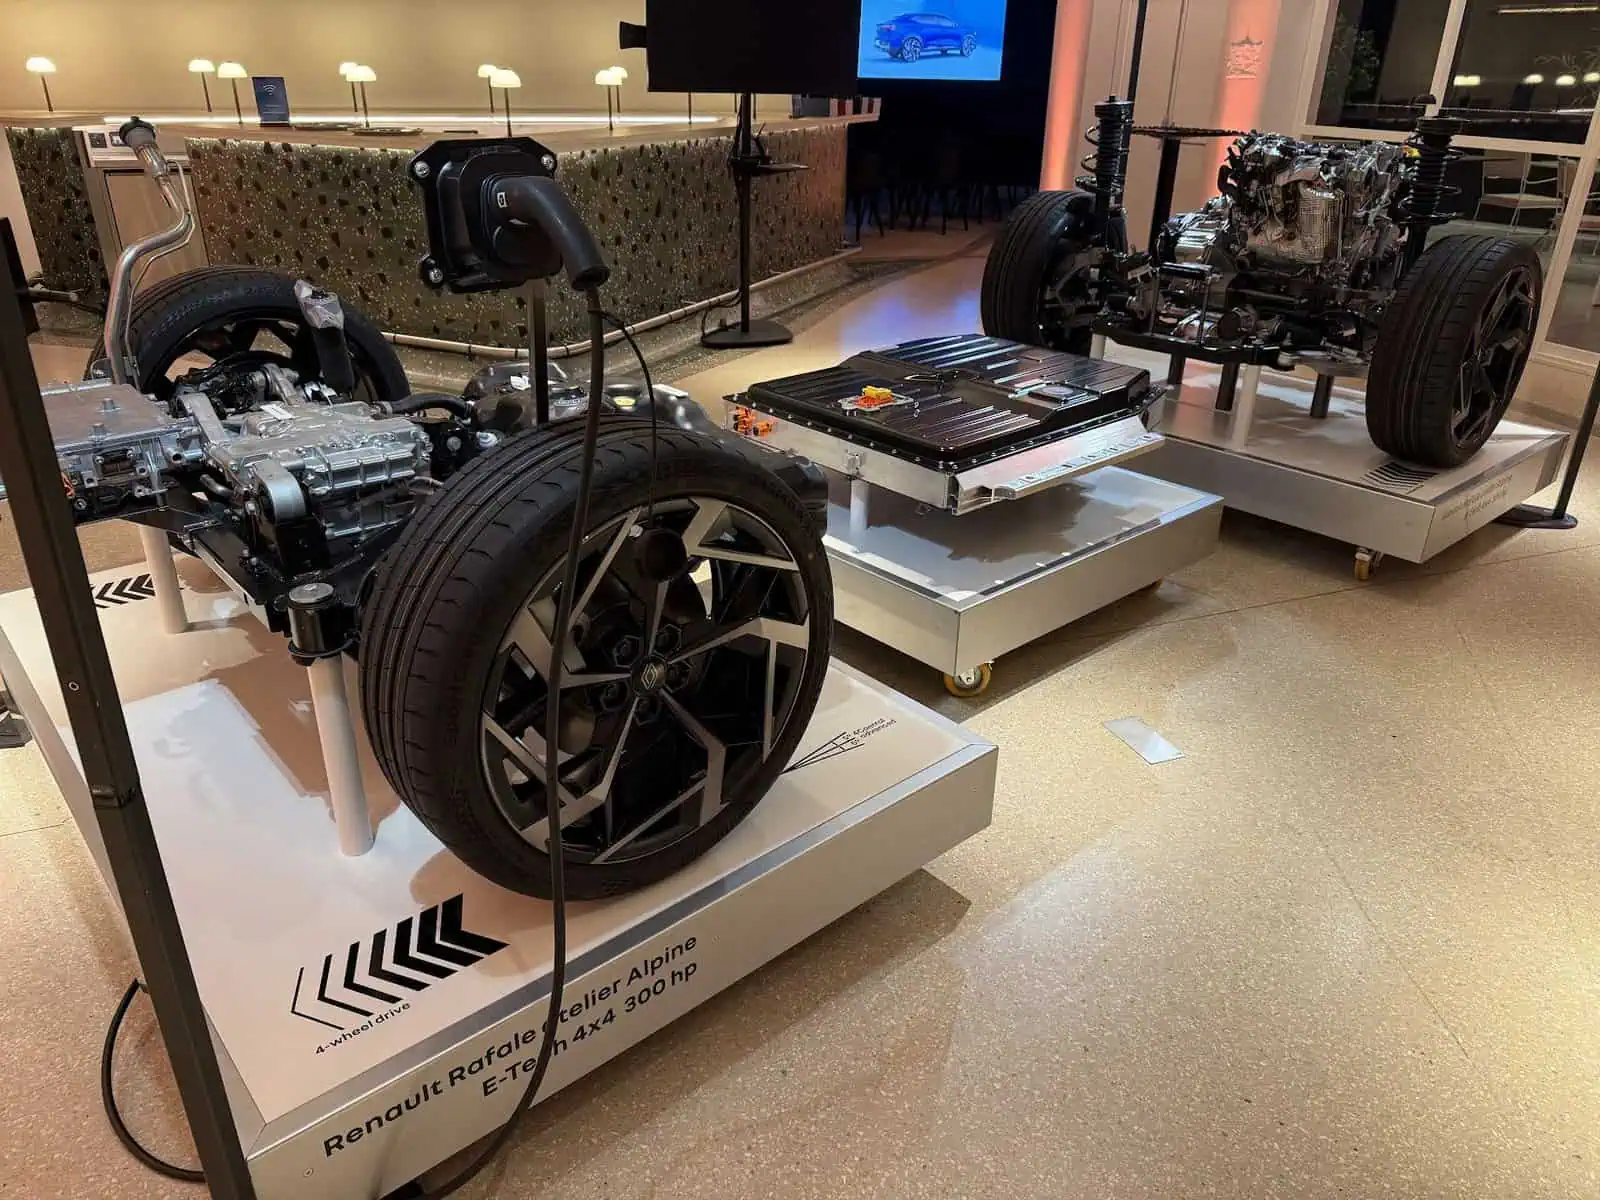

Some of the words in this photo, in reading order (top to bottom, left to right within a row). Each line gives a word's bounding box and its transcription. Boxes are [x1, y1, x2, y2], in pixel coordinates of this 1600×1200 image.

[316, 1020, 374, 1055] 4-wheel
[375, 1002, 411, 1024] drive
[323, 1080, 443, 1157] Renault
[449, 1029, 536, 1087] Rafale
[626, 936, 697, 987] Alpine
[482, 1039, 568, 1097] E-Teh
[572, 1007, 616, 1042] 4x4
[624, 978, 666, 1013] 300
[670, 962, 698, 986] hp
